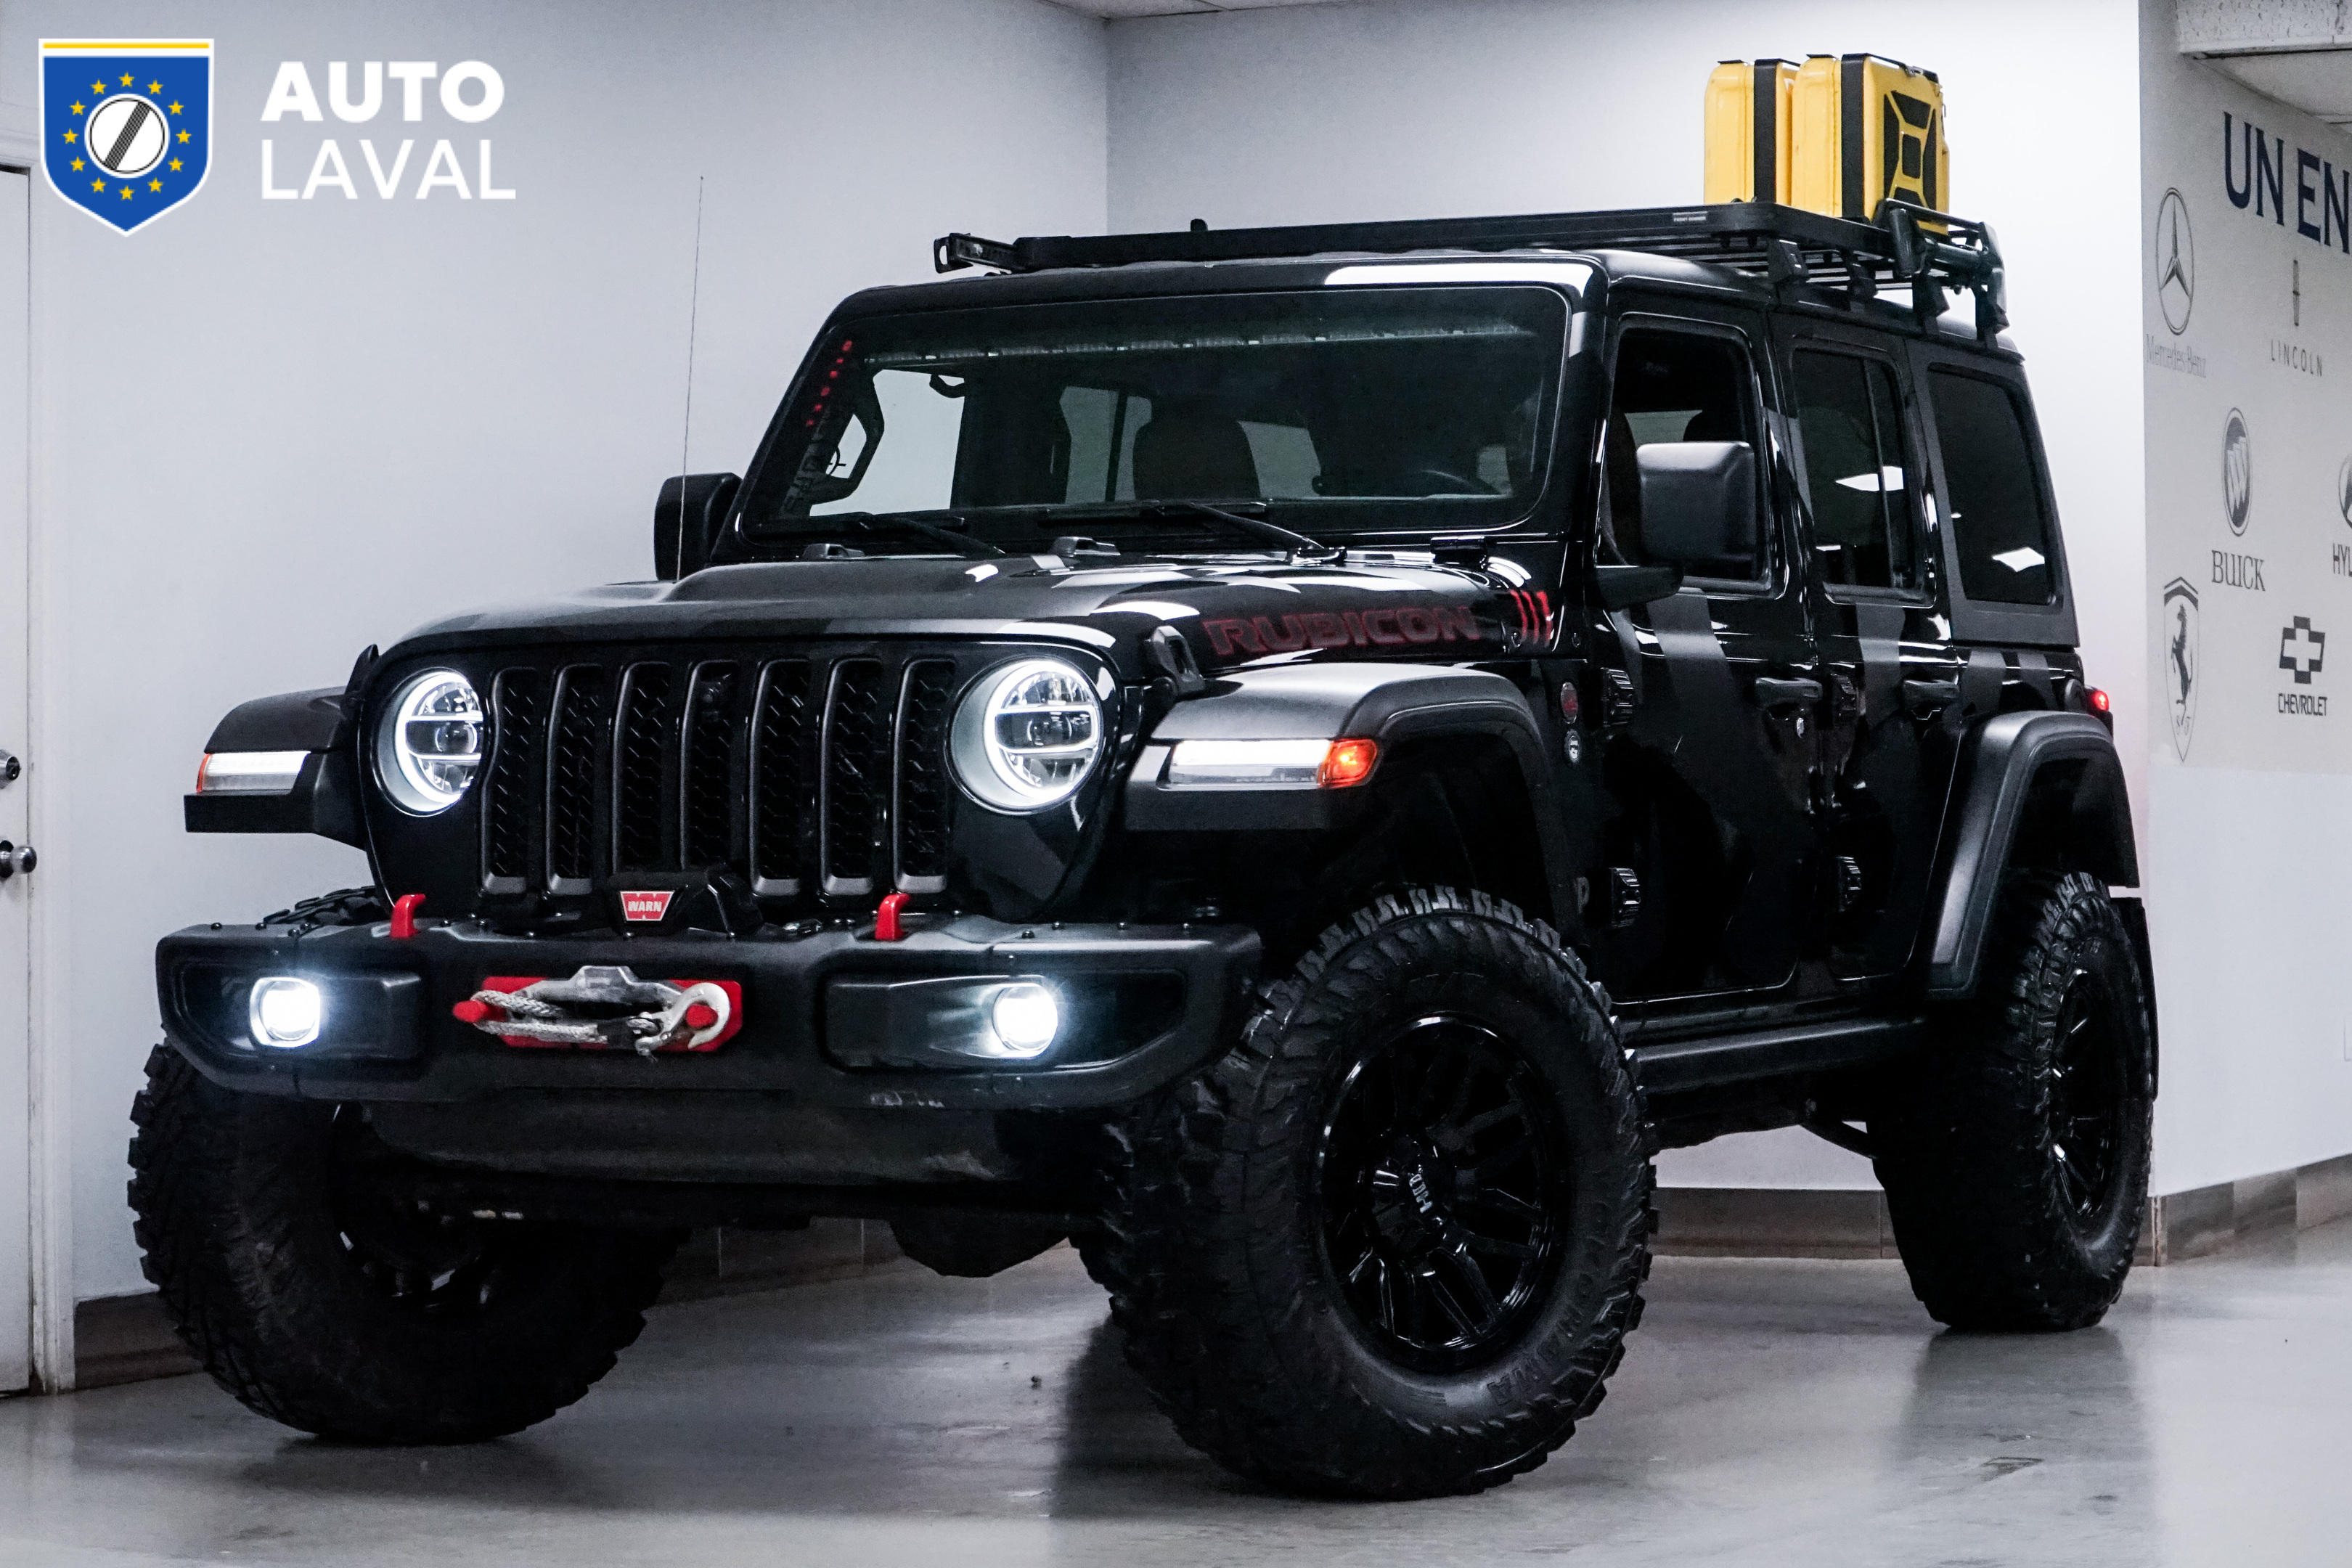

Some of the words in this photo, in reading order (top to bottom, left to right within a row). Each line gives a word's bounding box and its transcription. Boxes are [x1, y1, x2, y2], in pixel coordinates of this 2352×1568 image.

[2224, 111, 2284, 226] UN
[2297, 147, 2351, 255] EN
[2146, 333, 2207, 378] Mercedes-Benz
[2270, 339, 2323, 377] LINCOLN
[2211, 550, 2266, 592] BUICK
[1202, 606, 1482, 657] RUBICON
[2278, 693, 2327, 716] CHEVROLET
[628, 901, 662, 912] WARN
